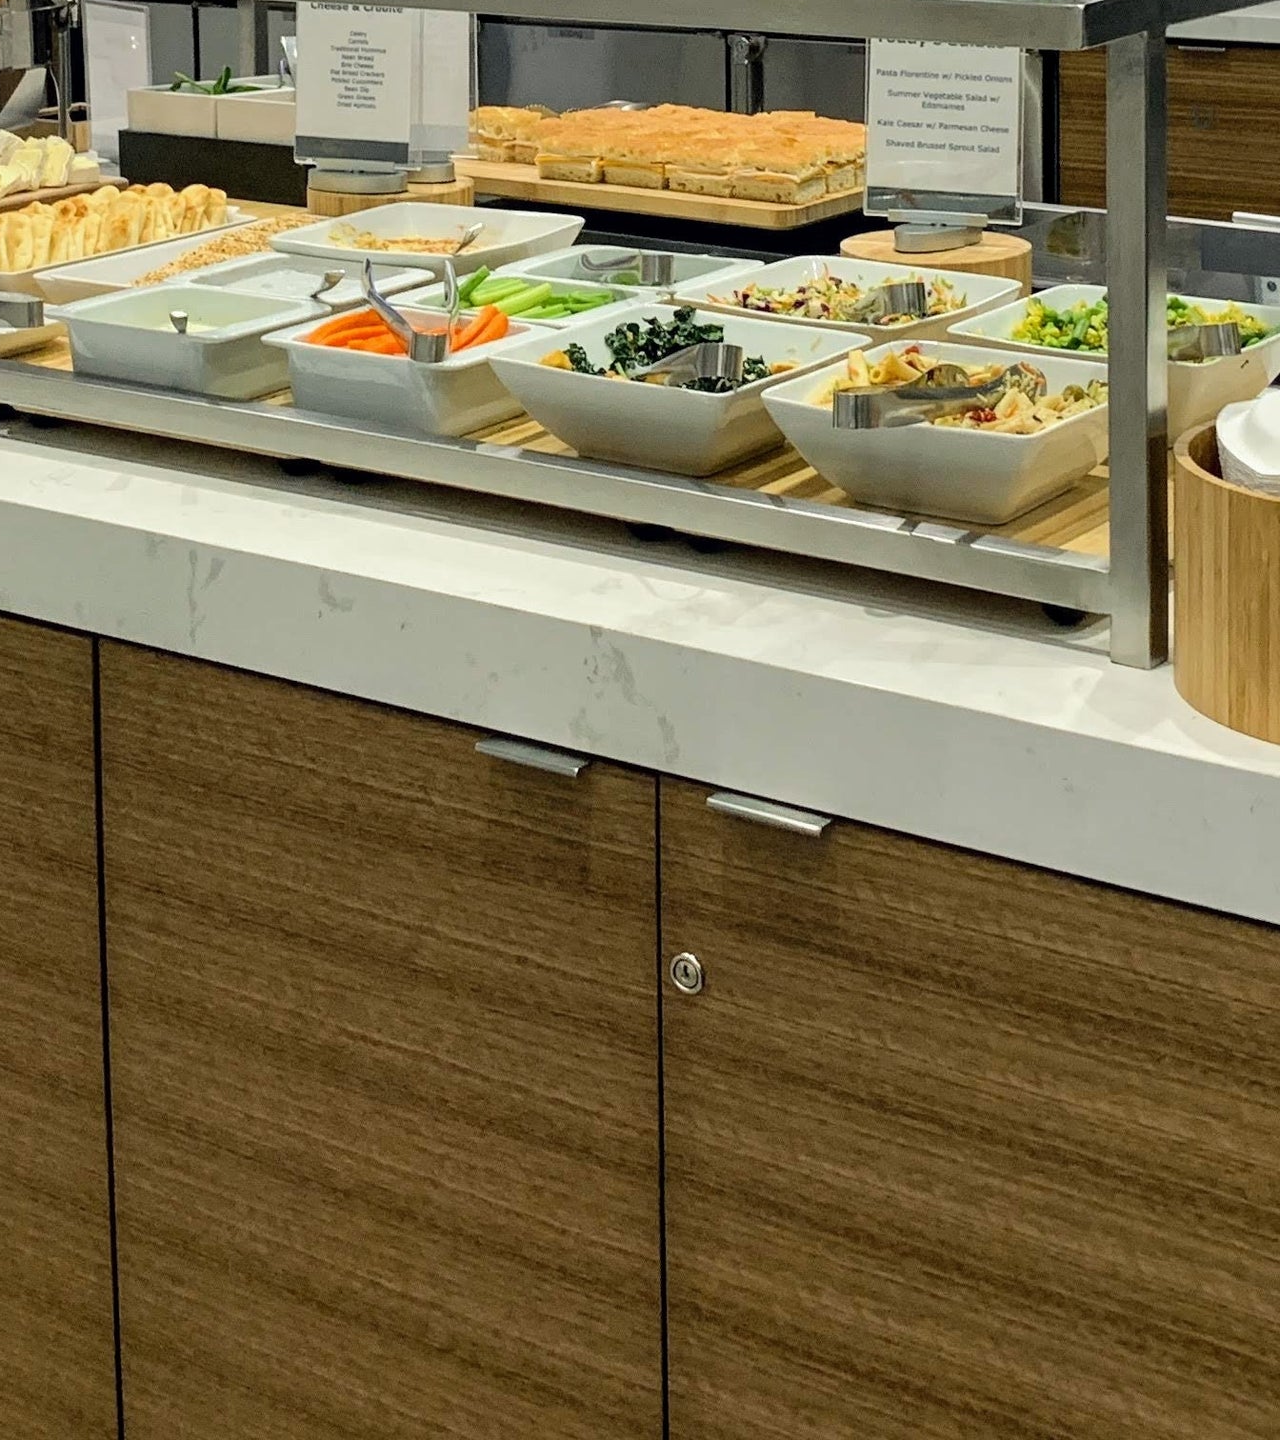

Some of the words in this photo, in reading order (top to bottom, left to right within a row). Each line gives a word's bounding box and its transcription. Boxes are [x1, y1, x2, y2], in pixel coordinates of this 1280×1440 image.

[311, 2, 349, 11] Cheese
[876, 68, 898, 77] Pasta
[887, 89, 921, 98] Summer
[922, 91, 963, 102] Vegetable
[896, 120, 923, 128] Caesar
[885, 139, 916, 148] Shaved
